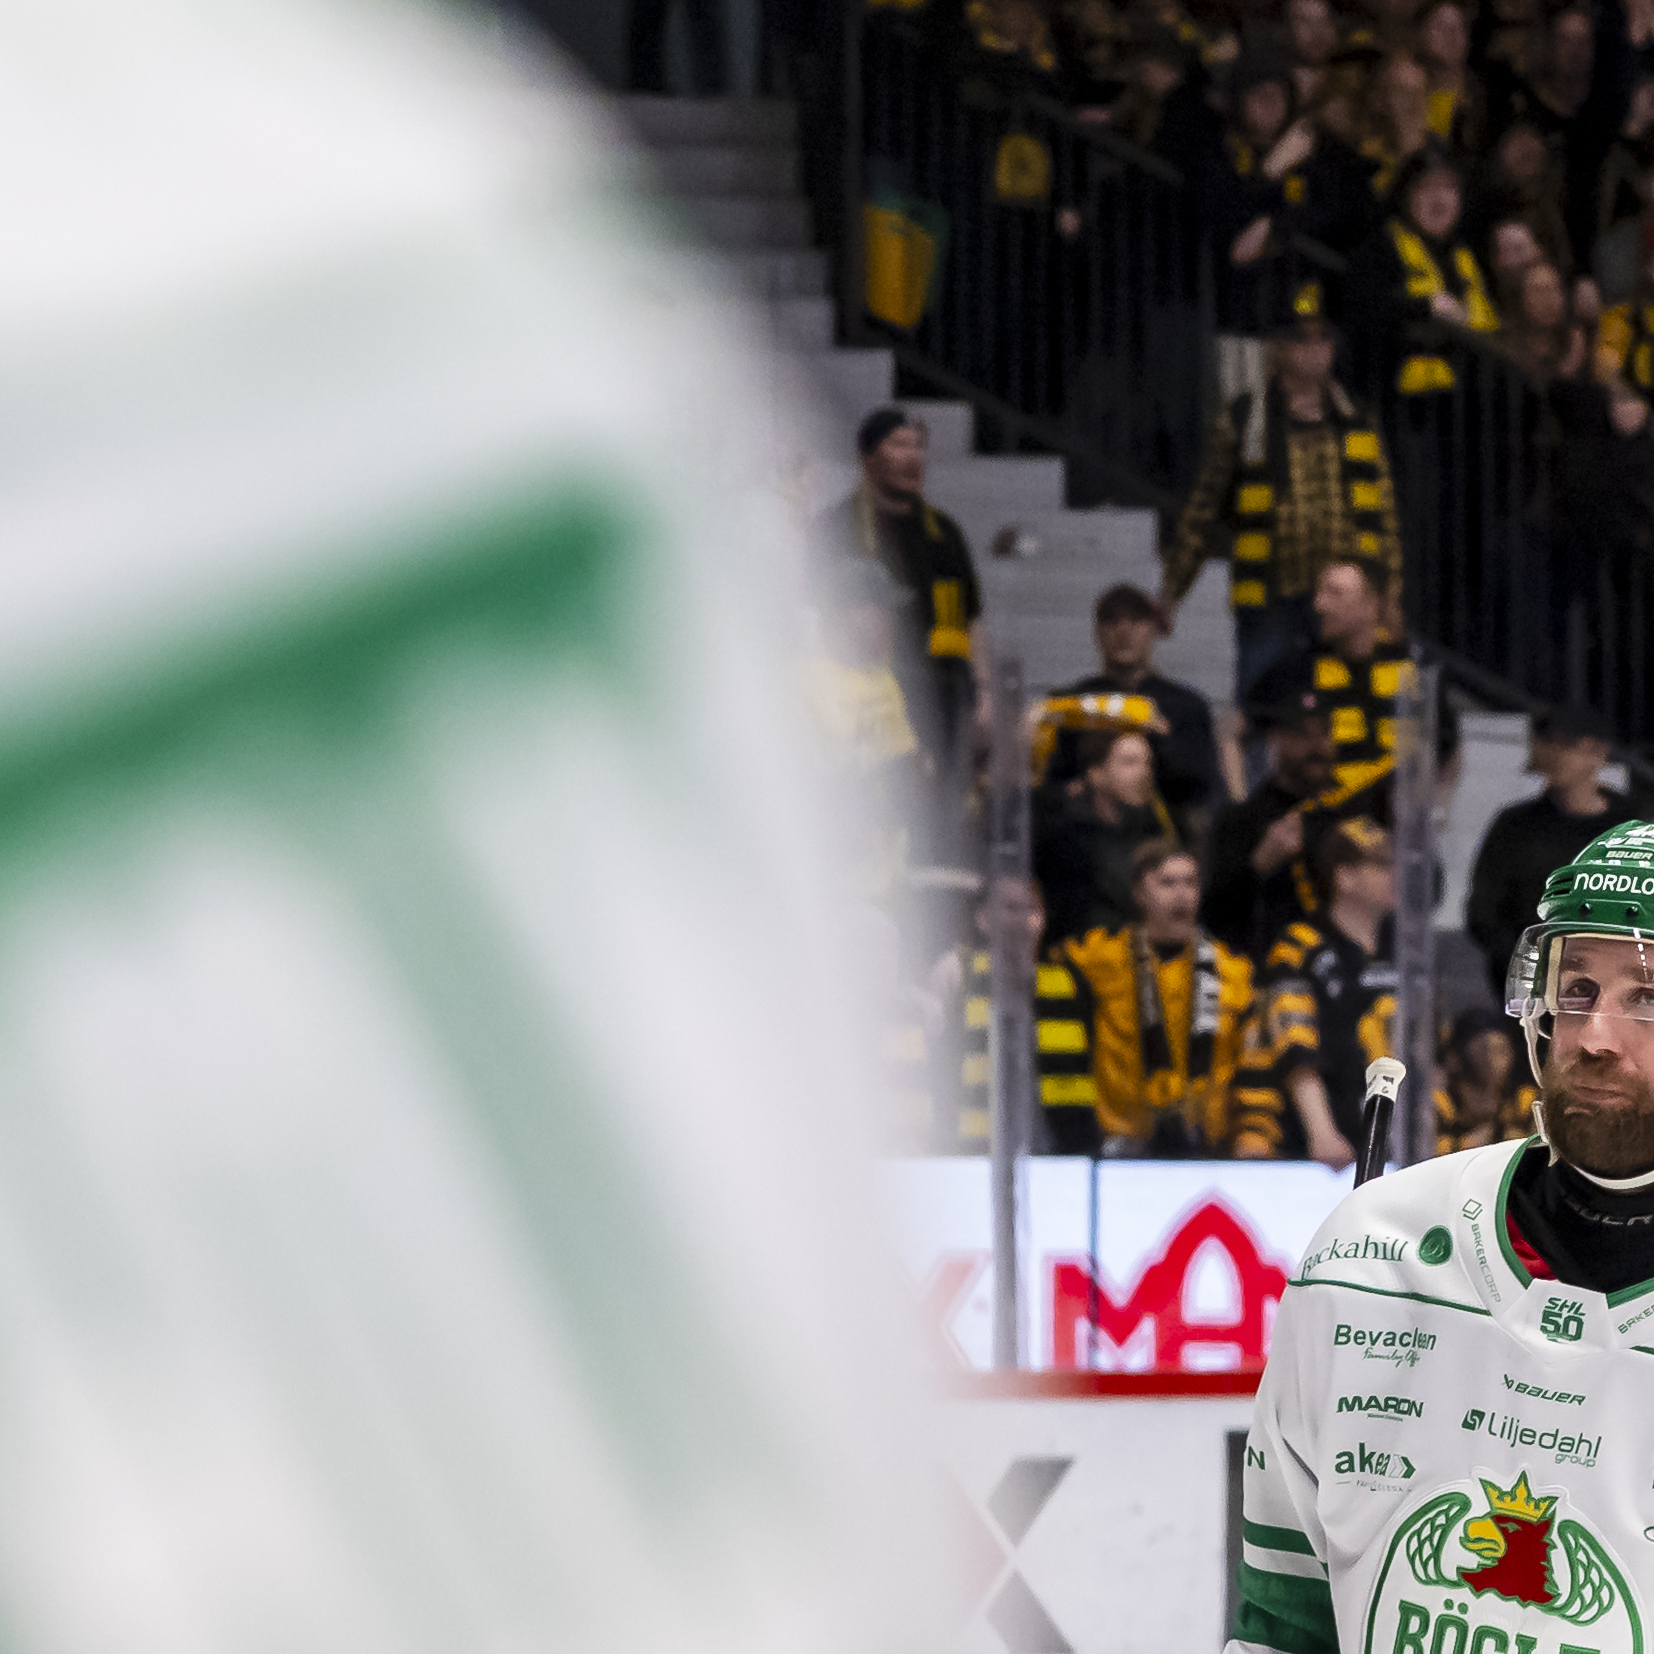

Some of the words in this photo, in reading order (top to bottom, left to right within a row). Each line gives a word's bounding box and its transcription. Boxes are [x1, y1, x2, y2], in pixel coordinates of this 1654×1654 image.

[1051, 1198, 1290, 1371] MA
[1546, 1297, 1586, 1317] SHL
[1540, 1311, 1585, 1342] 50
[1514, 1382, 1587, 1406] BAUER
[1488, 1413, 1602, 1458] Liljedahl
[1554, 1453, 1597, 1468] group
